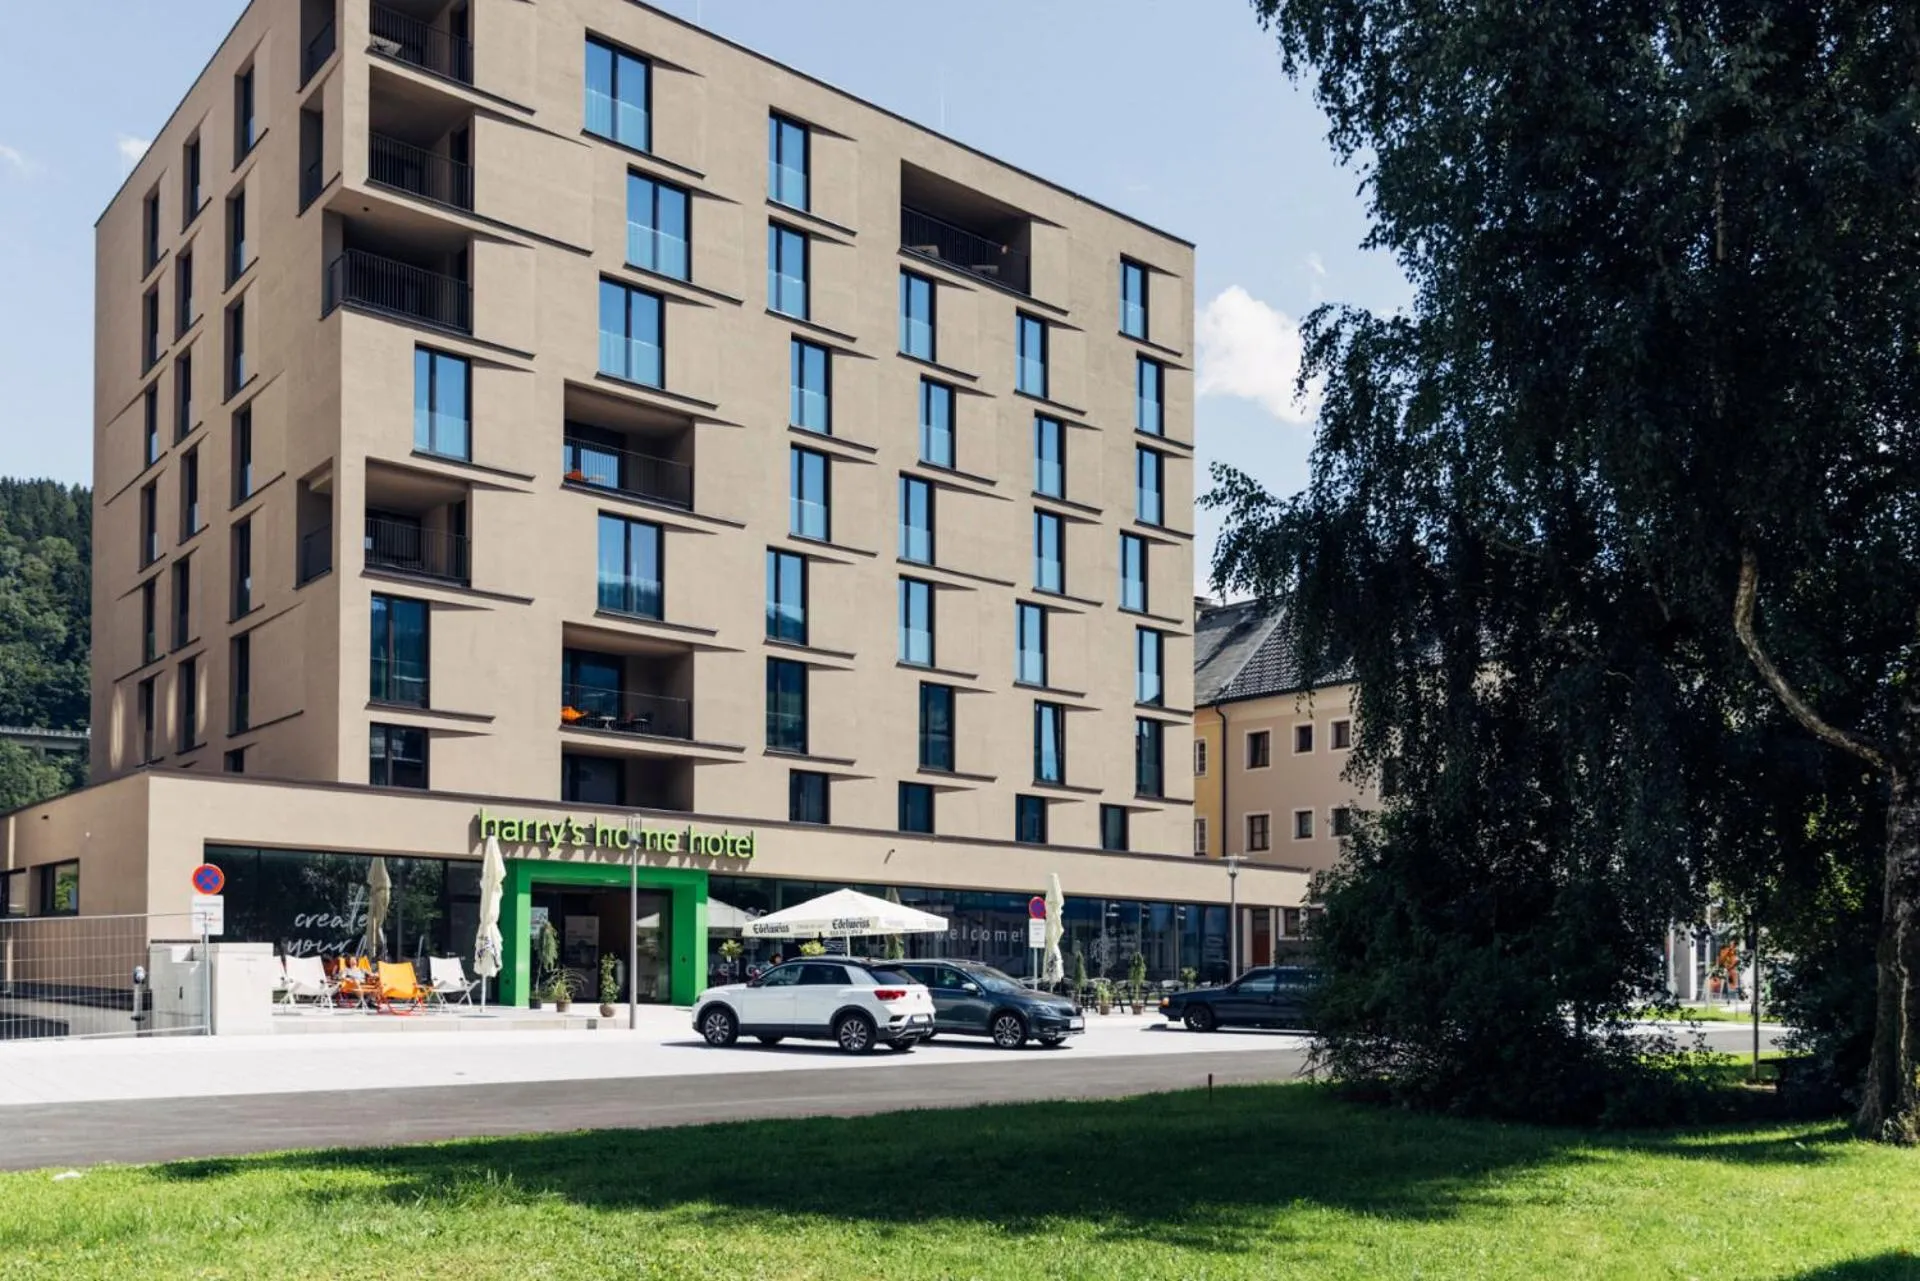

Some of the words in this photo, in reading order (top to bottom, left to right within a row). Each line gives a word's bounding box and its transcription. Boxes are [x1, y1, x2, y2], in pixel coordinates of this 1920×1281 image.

[480, 808, 586, 851] harry's
[595, 816, 680, 853] home
[689, 825, 757, 859] hotel
[294, 885, 369, 934] create
[287, 938, 351, 958] your
